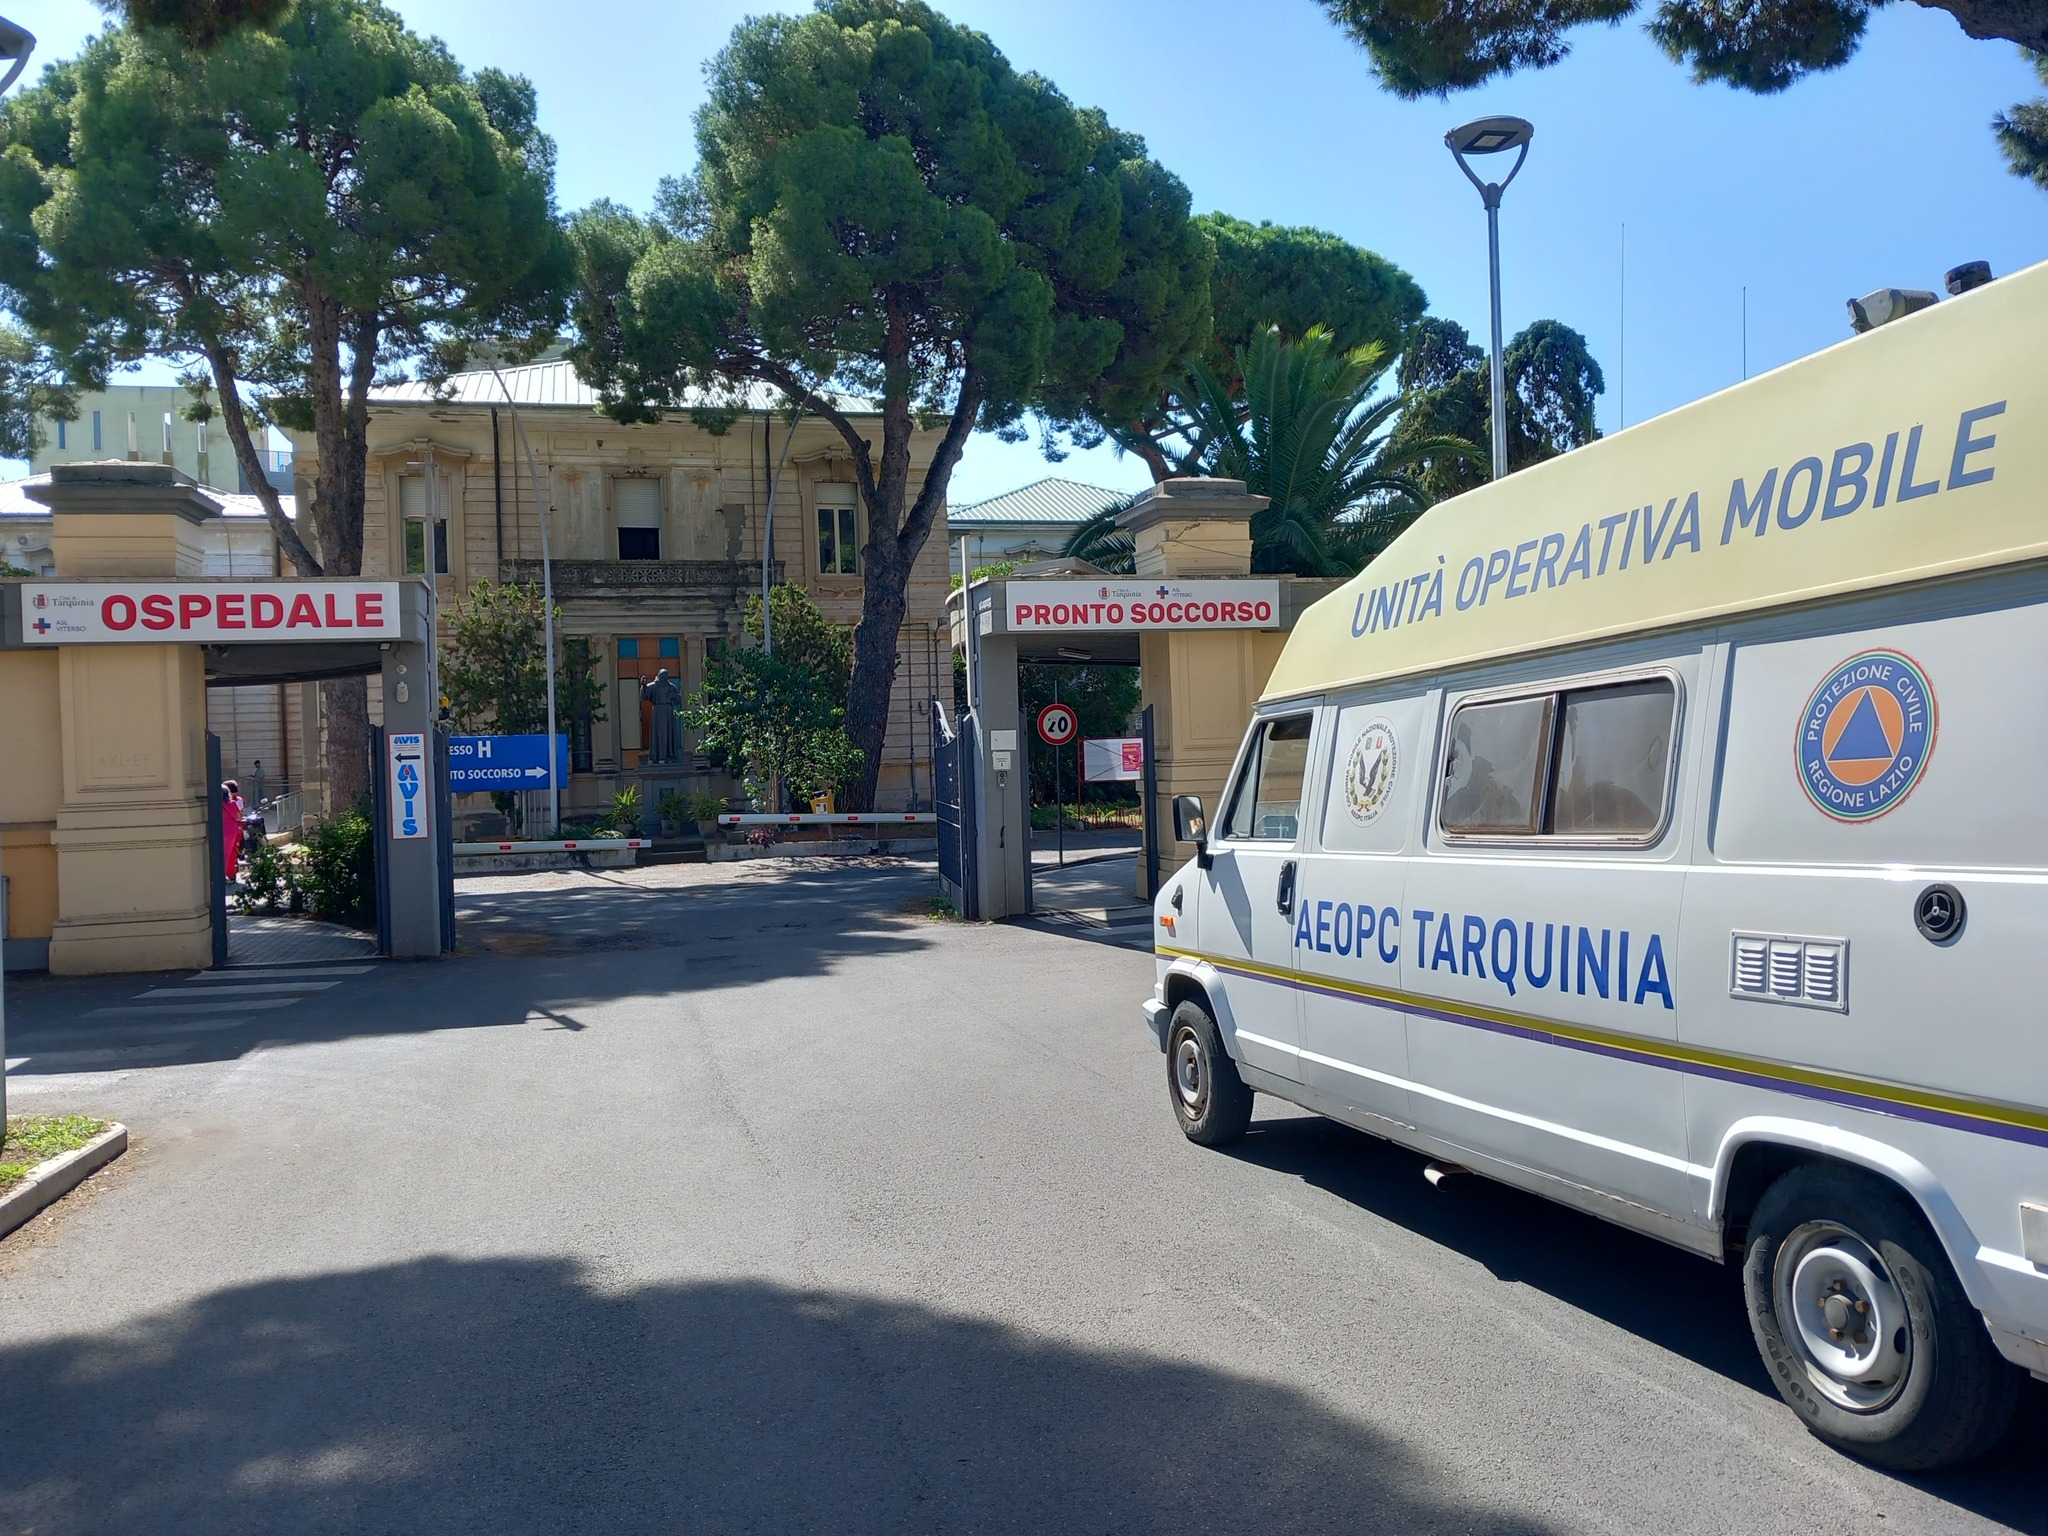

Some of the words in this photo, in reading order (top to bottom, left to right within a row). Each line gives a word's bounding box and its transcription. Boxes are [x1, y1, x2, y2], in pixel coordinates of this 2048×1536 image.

[1351, 555, 1446, 638] UNITÀ
[1454, 491, 1700, 612] OPERATIVA
[1720, 400, 2007, 546] MOBILE
[52, 598, 95, 608] Tarquinia
[101, 593, 384, 631] OSPEDALE
[1015, 602, 1124, 625] PRONTO
[1130, 601, 1271, 624] SOCCORSO
[1807, 664, 1893, 741] PROTEZIONE
[1896, 676, 1922, 733] CIVILE
[393, 736, 420, 744] AVIS
[449, 745, 473, 755] ESSO
[477, 740, 491, 758] H
[468, 768, 522, 780] SOCCORSO
[1808, 759, 1864, 807] REGIONE
[1868, 755, 1913, 804] LAZIO
[397, 764, 419, 836] AVIS
[1379, 780, 1394, 808] CIVILE
[1294, 899, 1399, 964] AEOPC
[1412, 909, 1675, 1010] TARQUINIA
